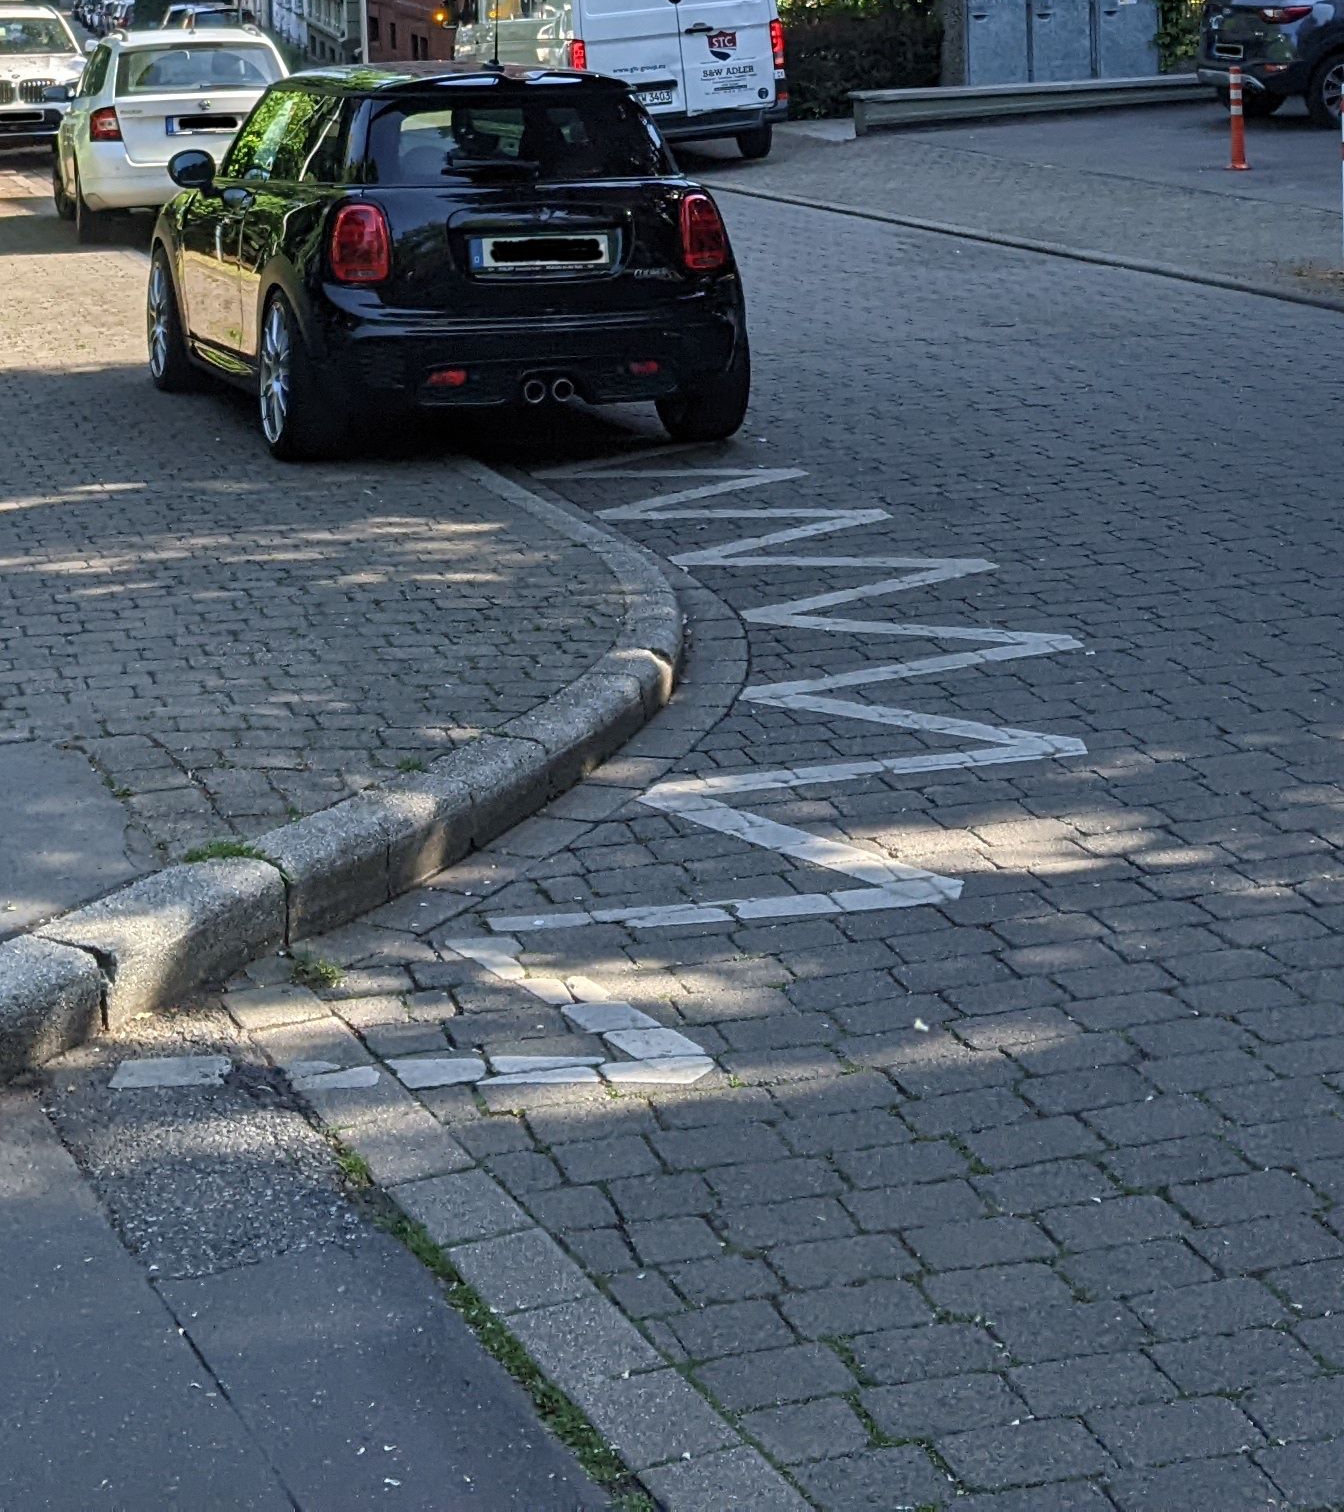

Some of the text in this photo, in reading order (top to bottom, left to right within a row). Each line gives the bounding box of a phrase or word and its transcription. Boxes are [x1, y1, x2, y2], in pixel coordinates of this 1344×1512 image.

[712, 36, 734, 48] STC
[726, 65, 754, 76] ADLER
[649, 90, 671, 103] 3403
